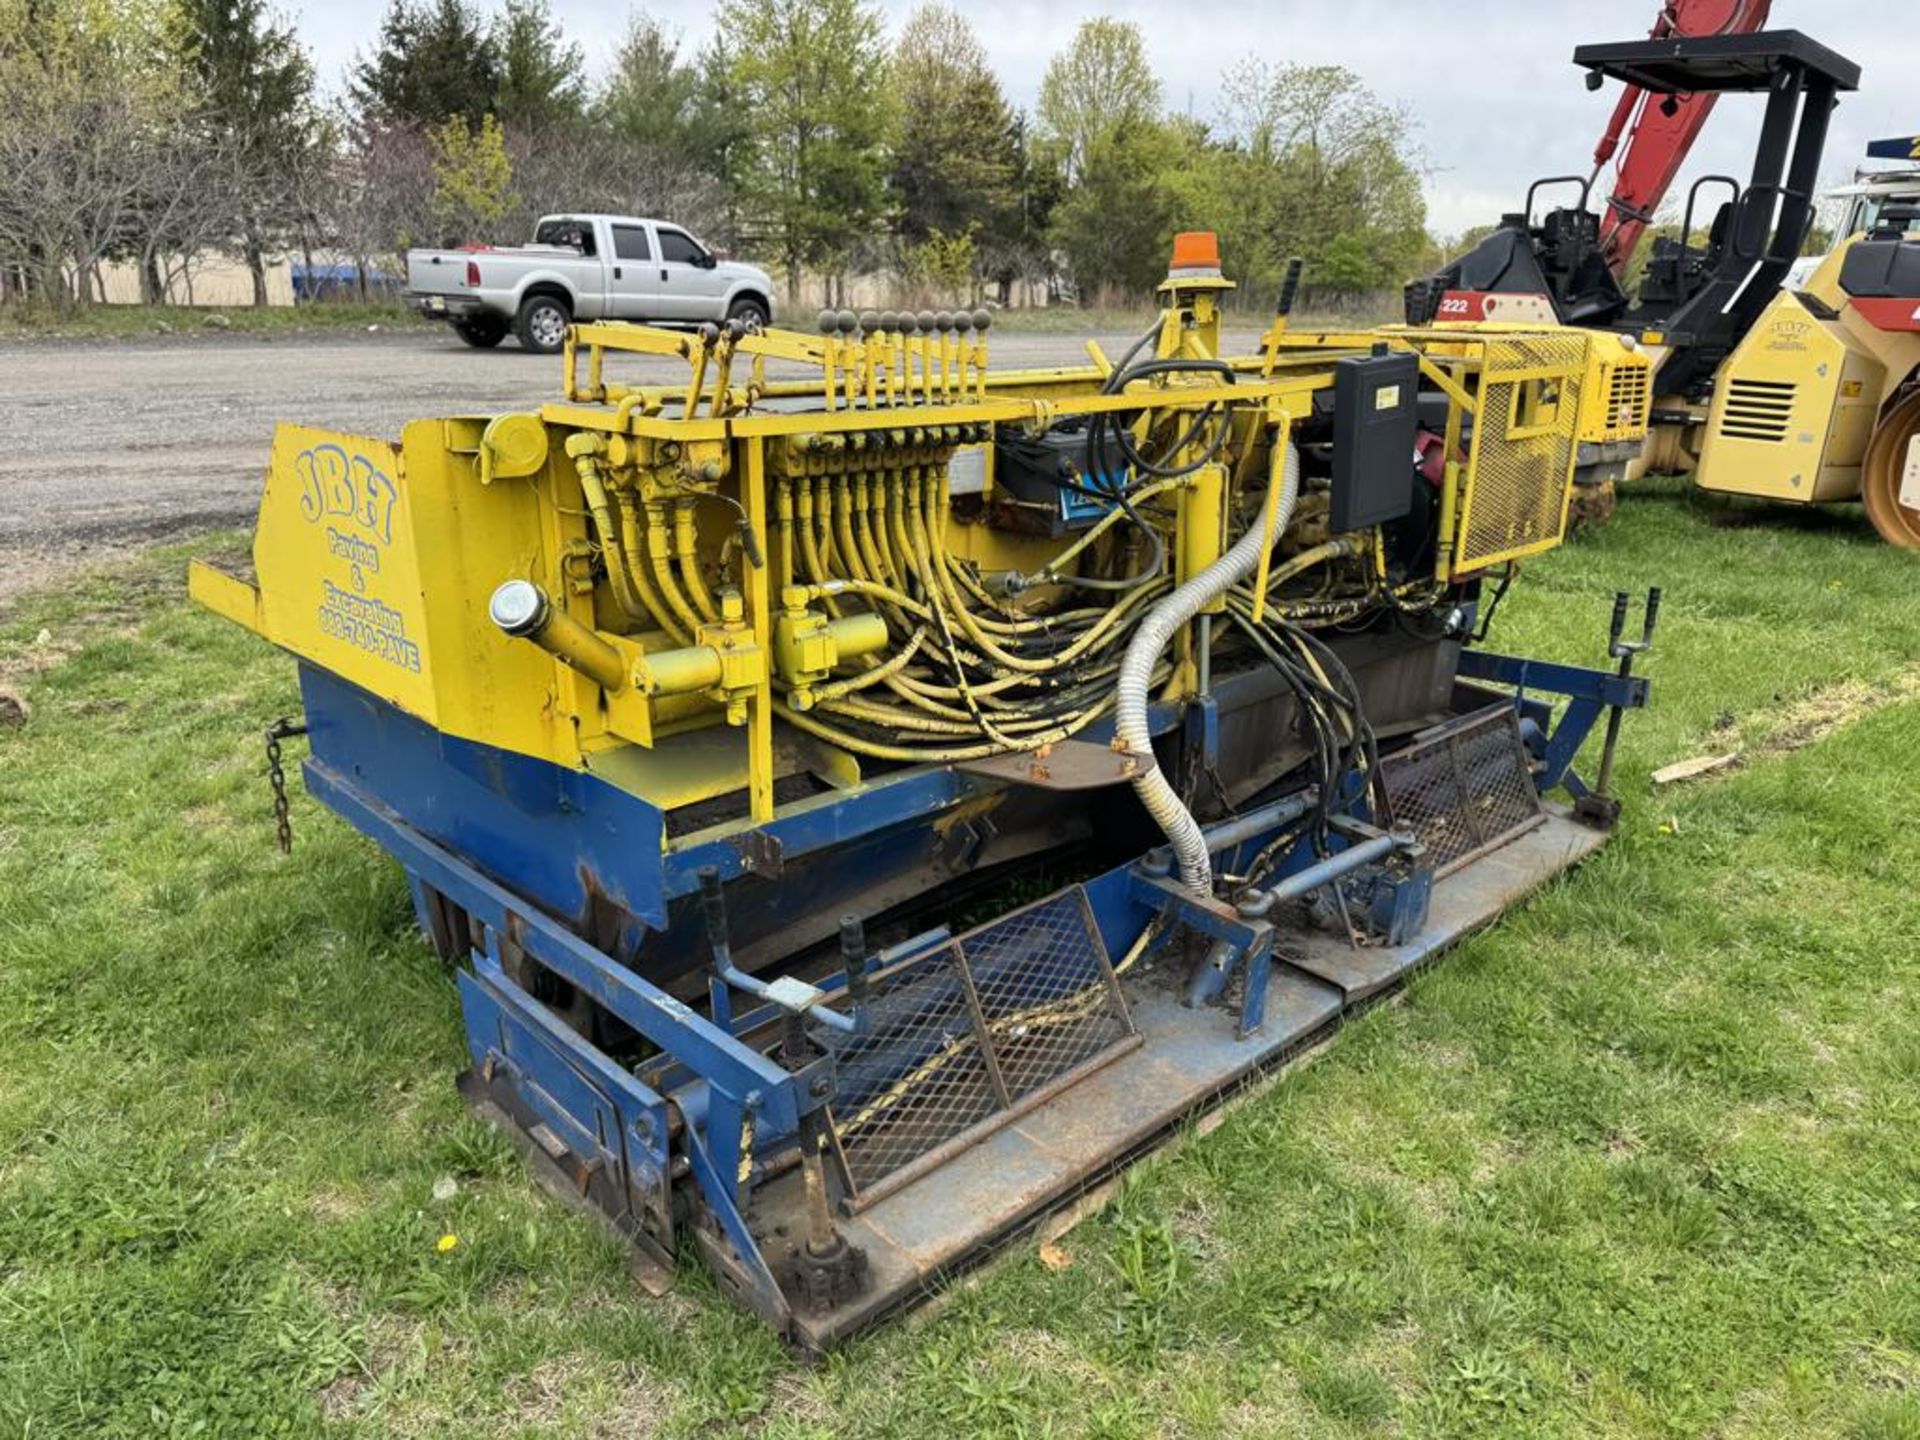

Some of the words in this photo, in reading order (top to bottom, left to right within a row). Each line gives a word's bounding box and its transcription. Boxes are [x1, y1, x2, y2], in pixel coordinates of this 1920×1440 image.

[296, 444, 397, 545] JBH
[327, 526, 379, 573] Paving
[350, 563, 365, 593] &
